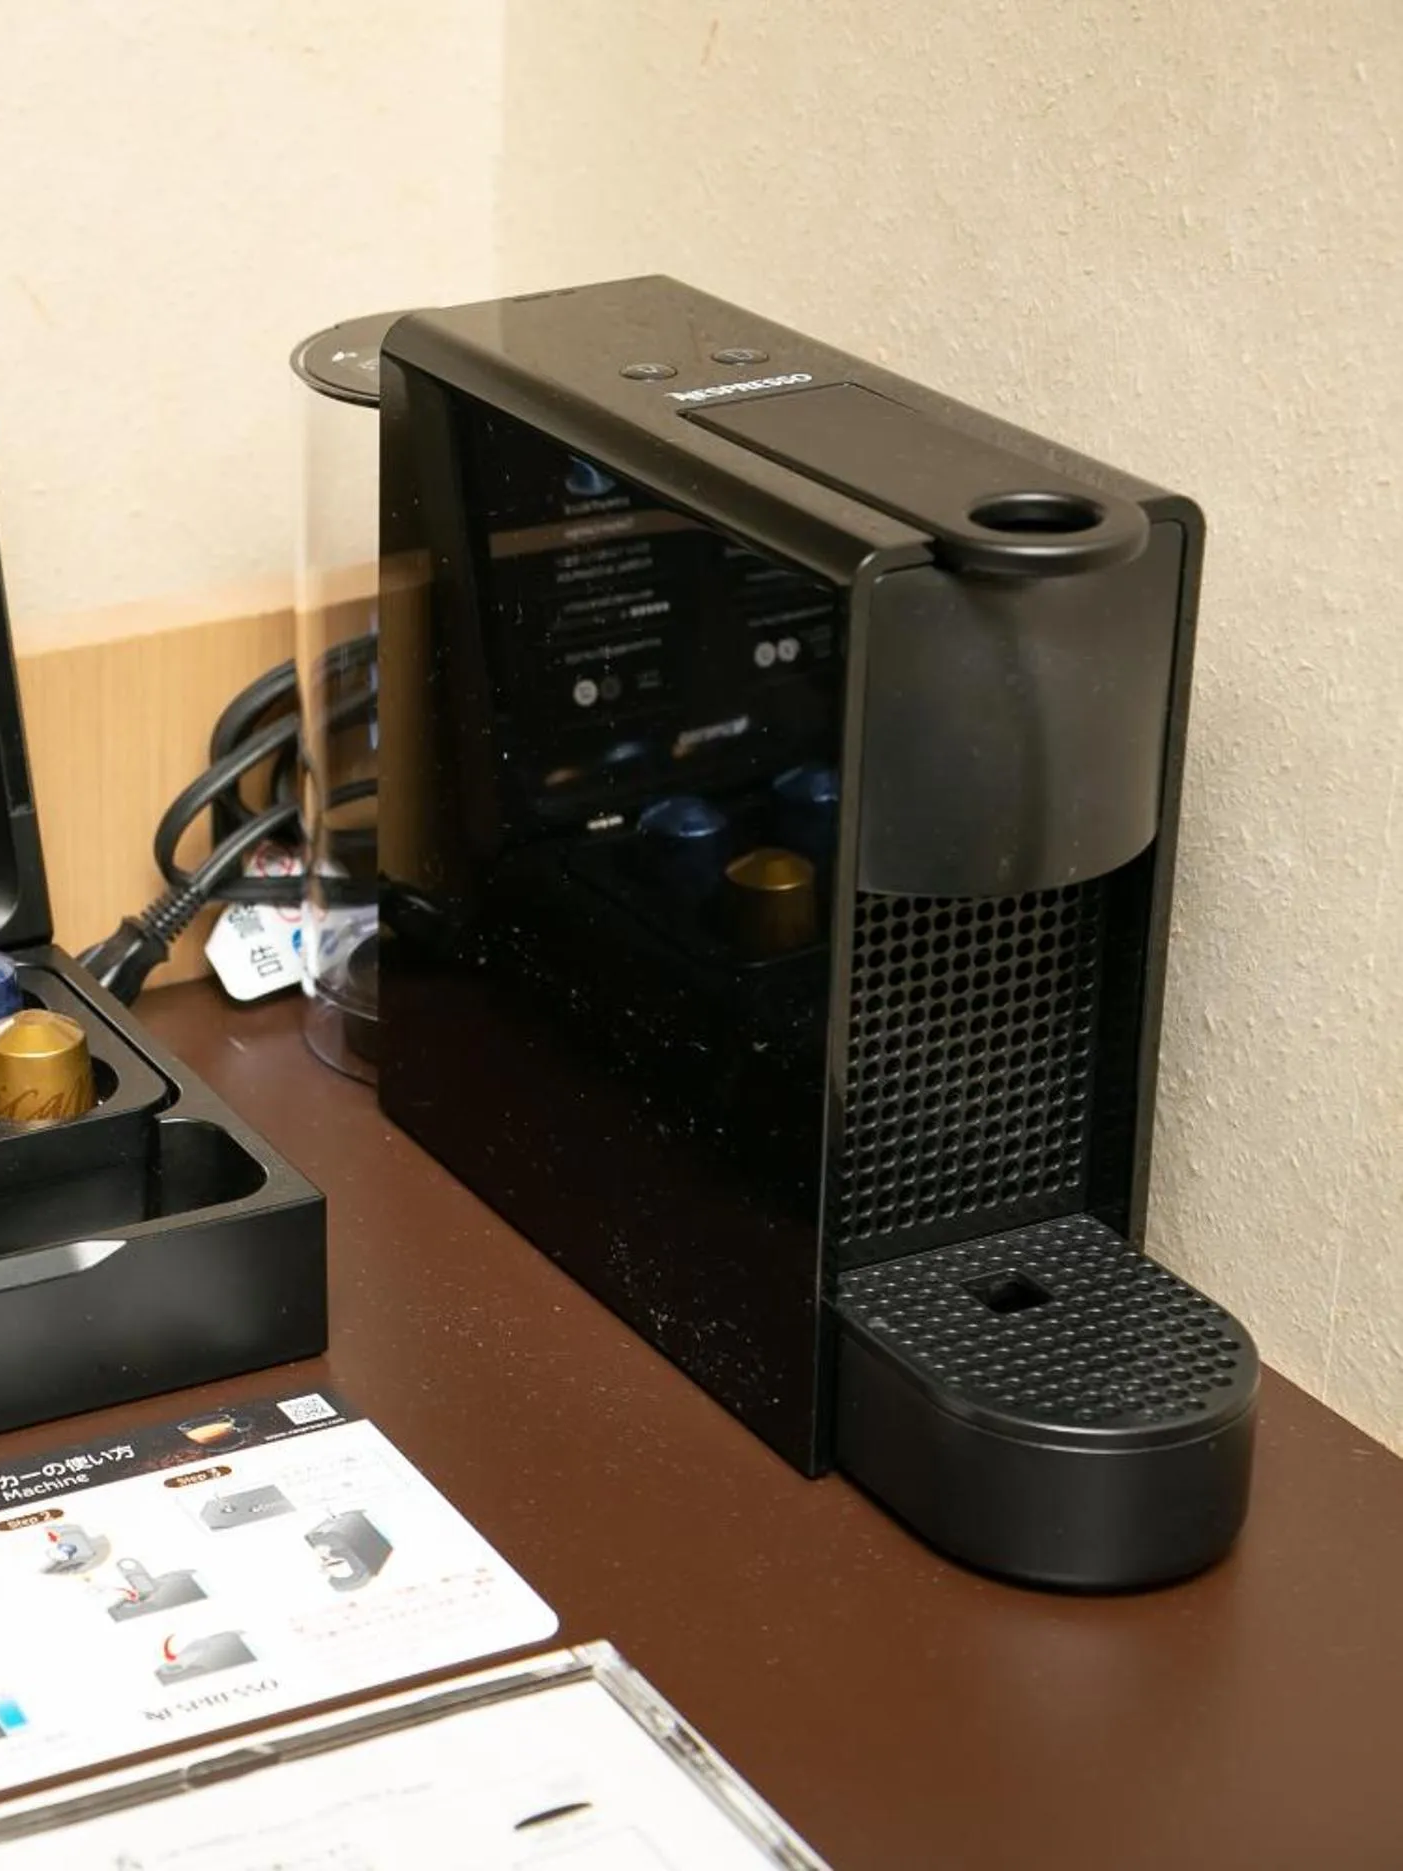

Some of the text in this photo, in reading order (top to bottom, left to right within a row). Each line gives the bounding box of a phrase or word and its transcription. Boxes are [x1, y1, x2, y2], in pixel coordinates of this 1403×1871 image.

[664, 372, 813, 401] NESPRESSO
[2, 1472, 91, 1502] Machine
[6, 1511, 52, 1530] Step 2
